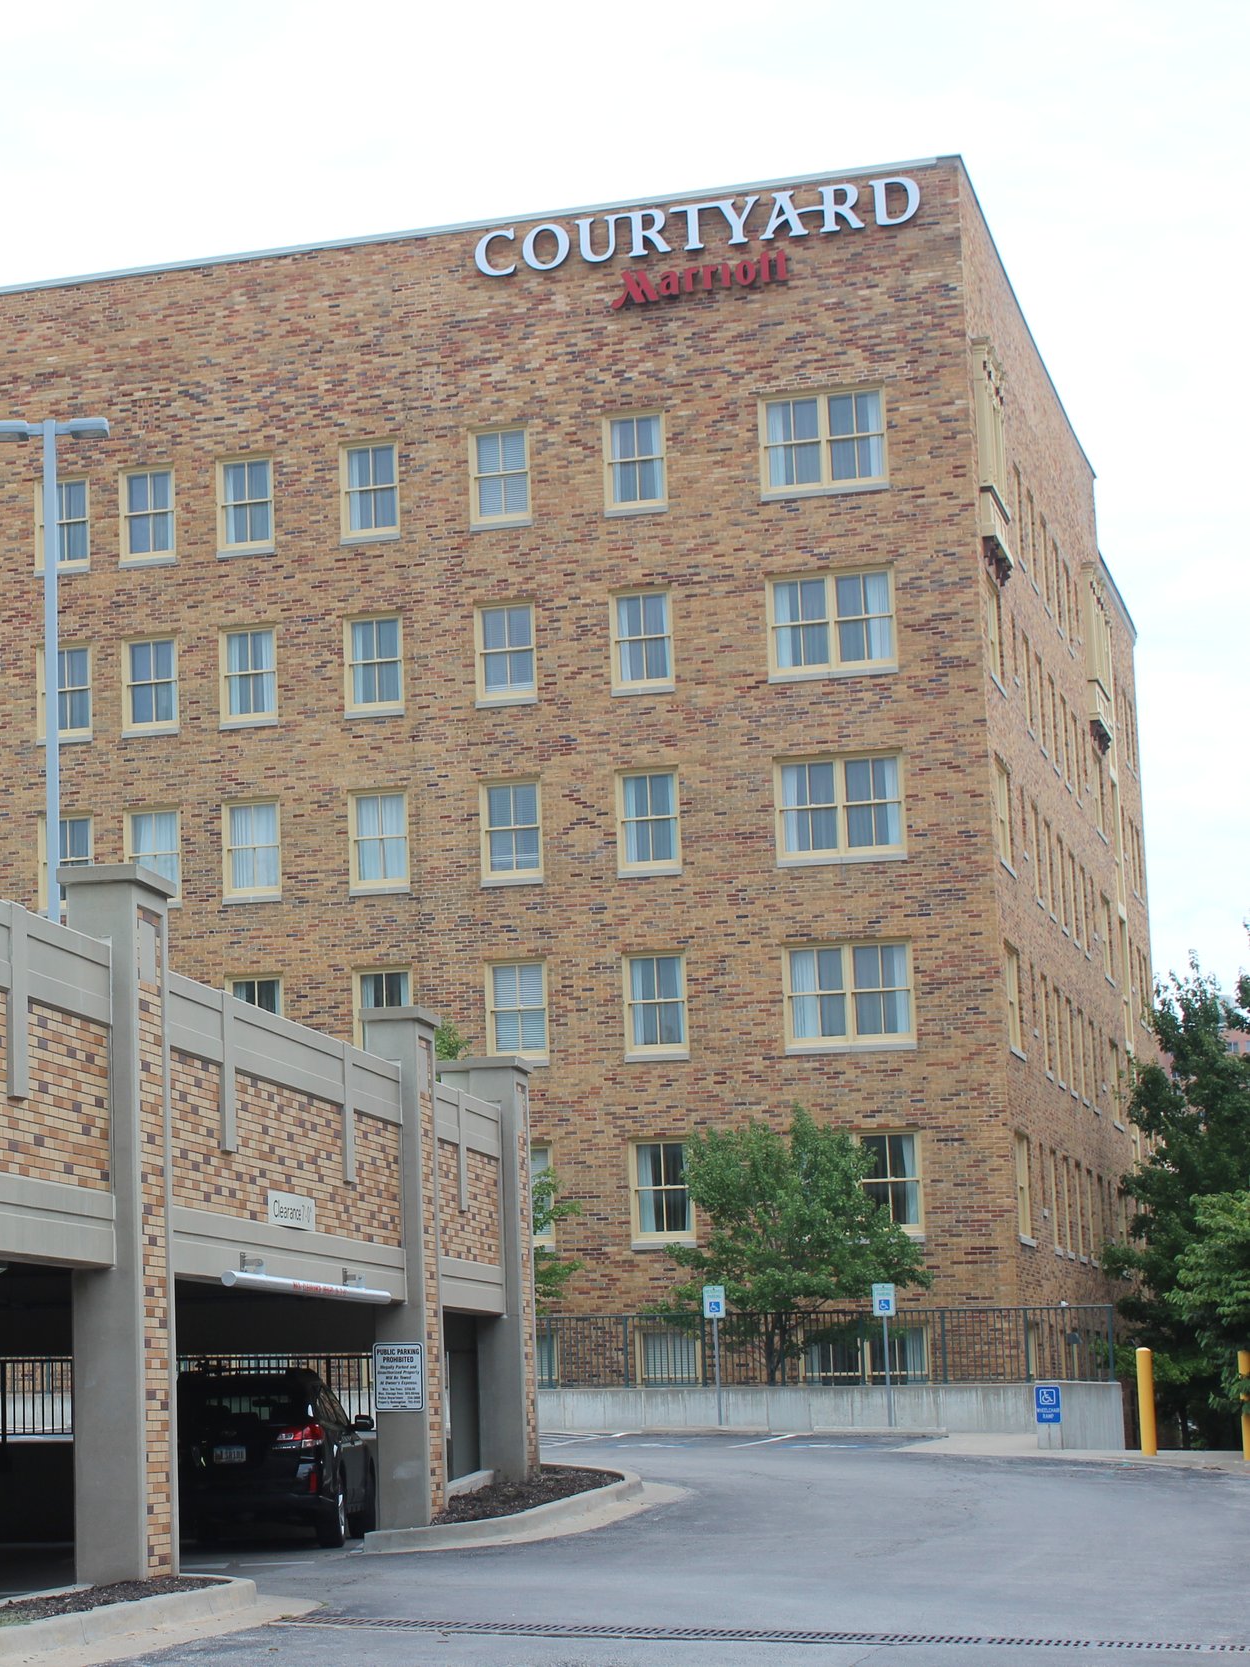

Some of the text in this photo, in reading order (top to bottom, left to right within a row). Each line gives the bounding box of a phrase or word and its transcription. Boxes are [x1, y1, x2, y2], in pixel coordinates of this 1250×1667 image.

[474, 177, 921, 277] COURTYARD
[611, 249, 789, 309] Marriott
[273, 1199, 301, 1221] Clearance
